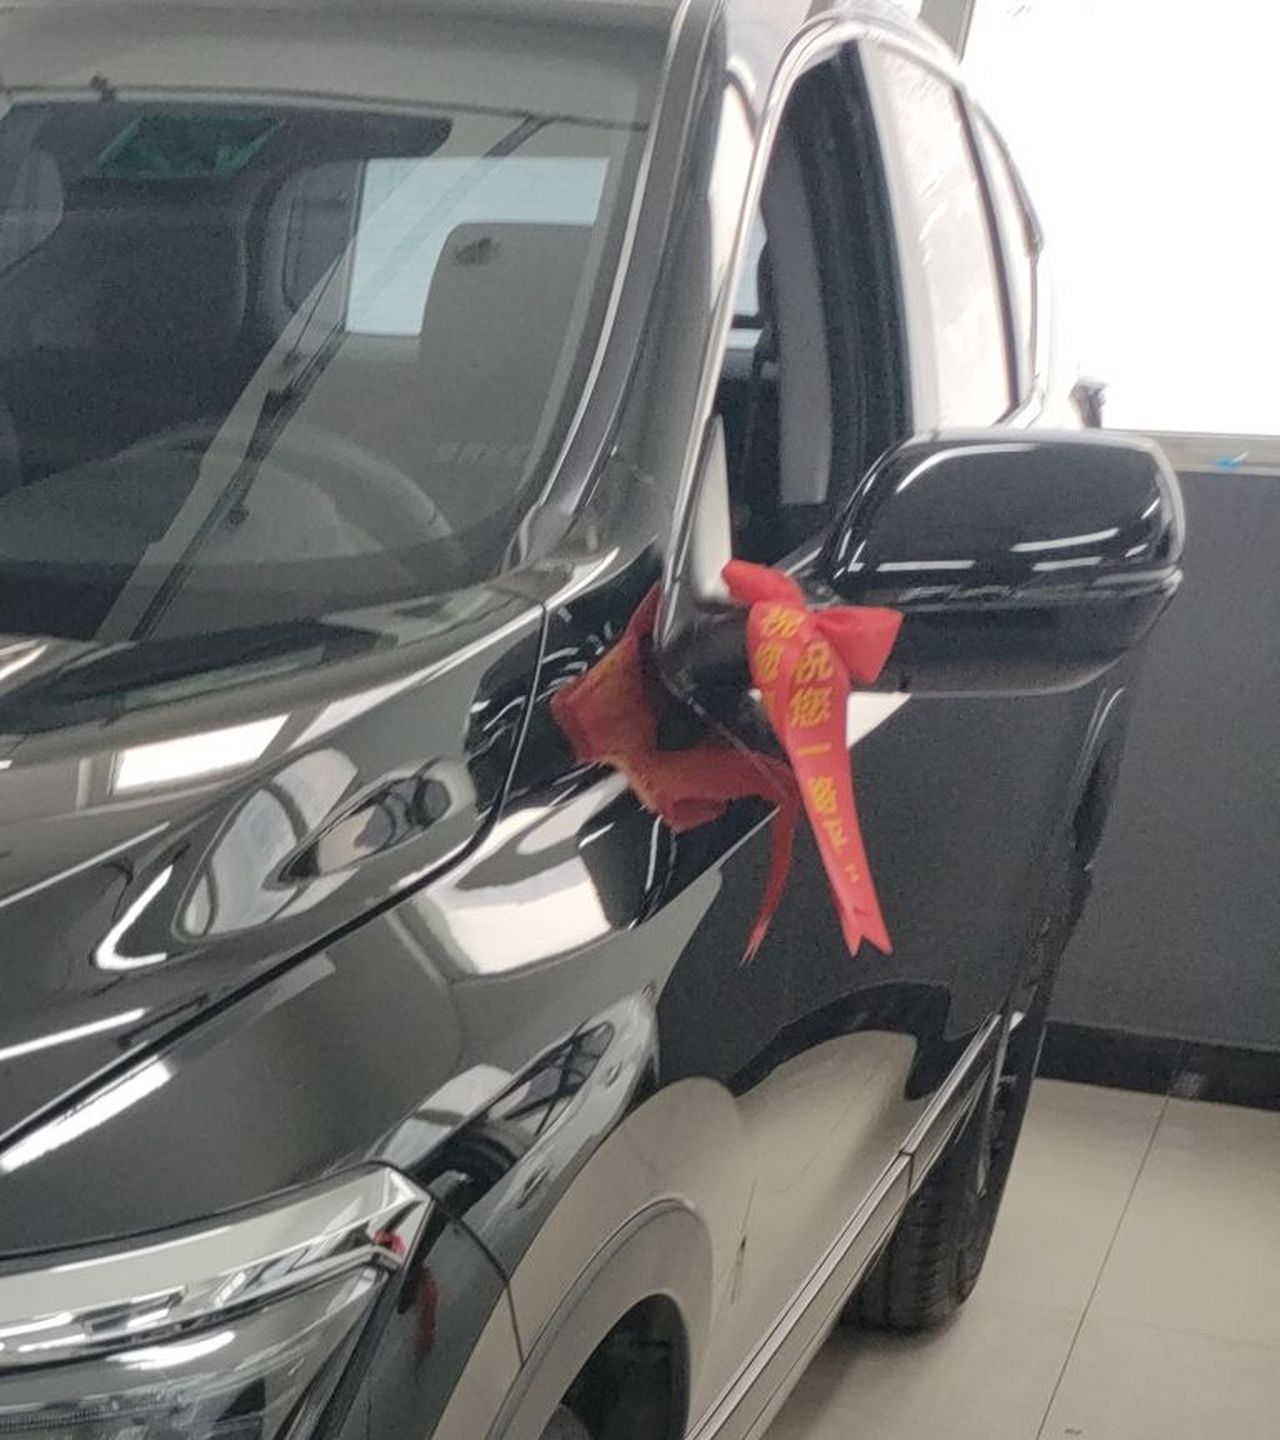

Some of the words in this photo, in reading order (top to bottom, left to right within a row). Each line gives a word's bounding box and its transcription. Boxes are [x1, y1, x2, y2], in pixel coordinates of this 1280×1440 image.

[789, 639, 860, 884] 祝您一路平
